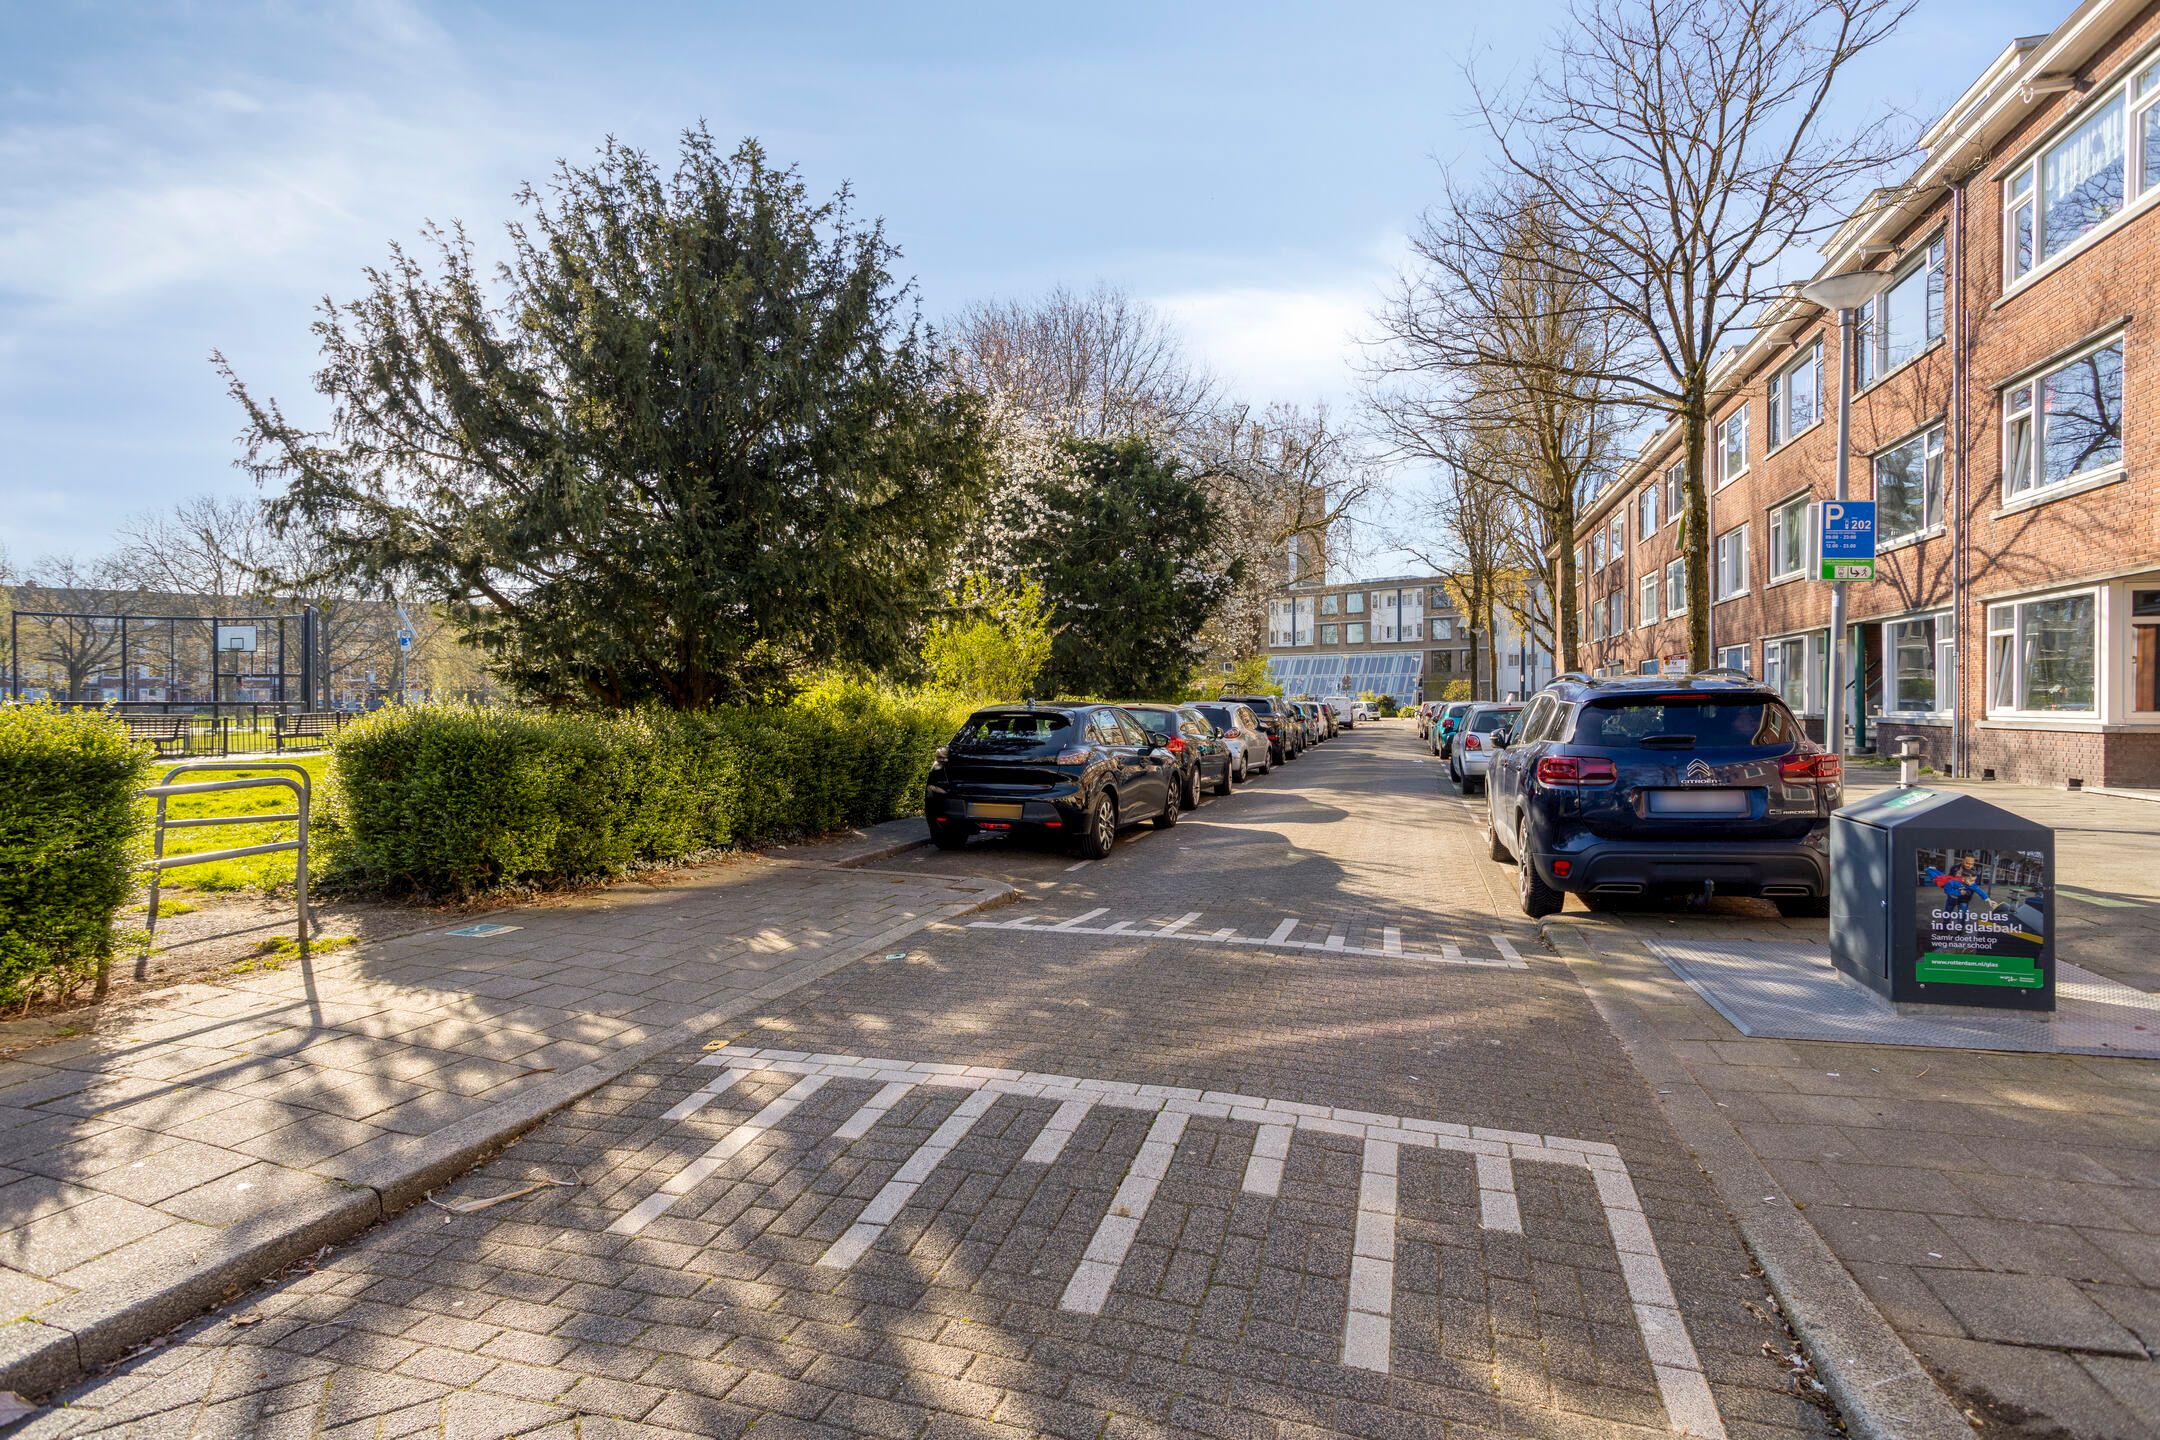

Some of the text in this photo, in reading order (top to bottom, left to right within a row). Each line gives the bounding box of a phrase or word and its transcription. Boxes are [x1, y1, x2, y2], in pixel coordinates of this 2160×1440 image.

[1825, 504, 1844, 529] P
[1851, 520, 1871, 529] 202
[1931, 908, 2009, 922] Gooi je glas
[1931, 920, 2022, 933] in de glasbak!
[1931, 933, 1953, 941] Samir
[1955, 934, 1972, 942] doet
[1973, 935, 1985, 943] het
[1931, 959, 1998, 968] www.rotterdam.nl/glas
